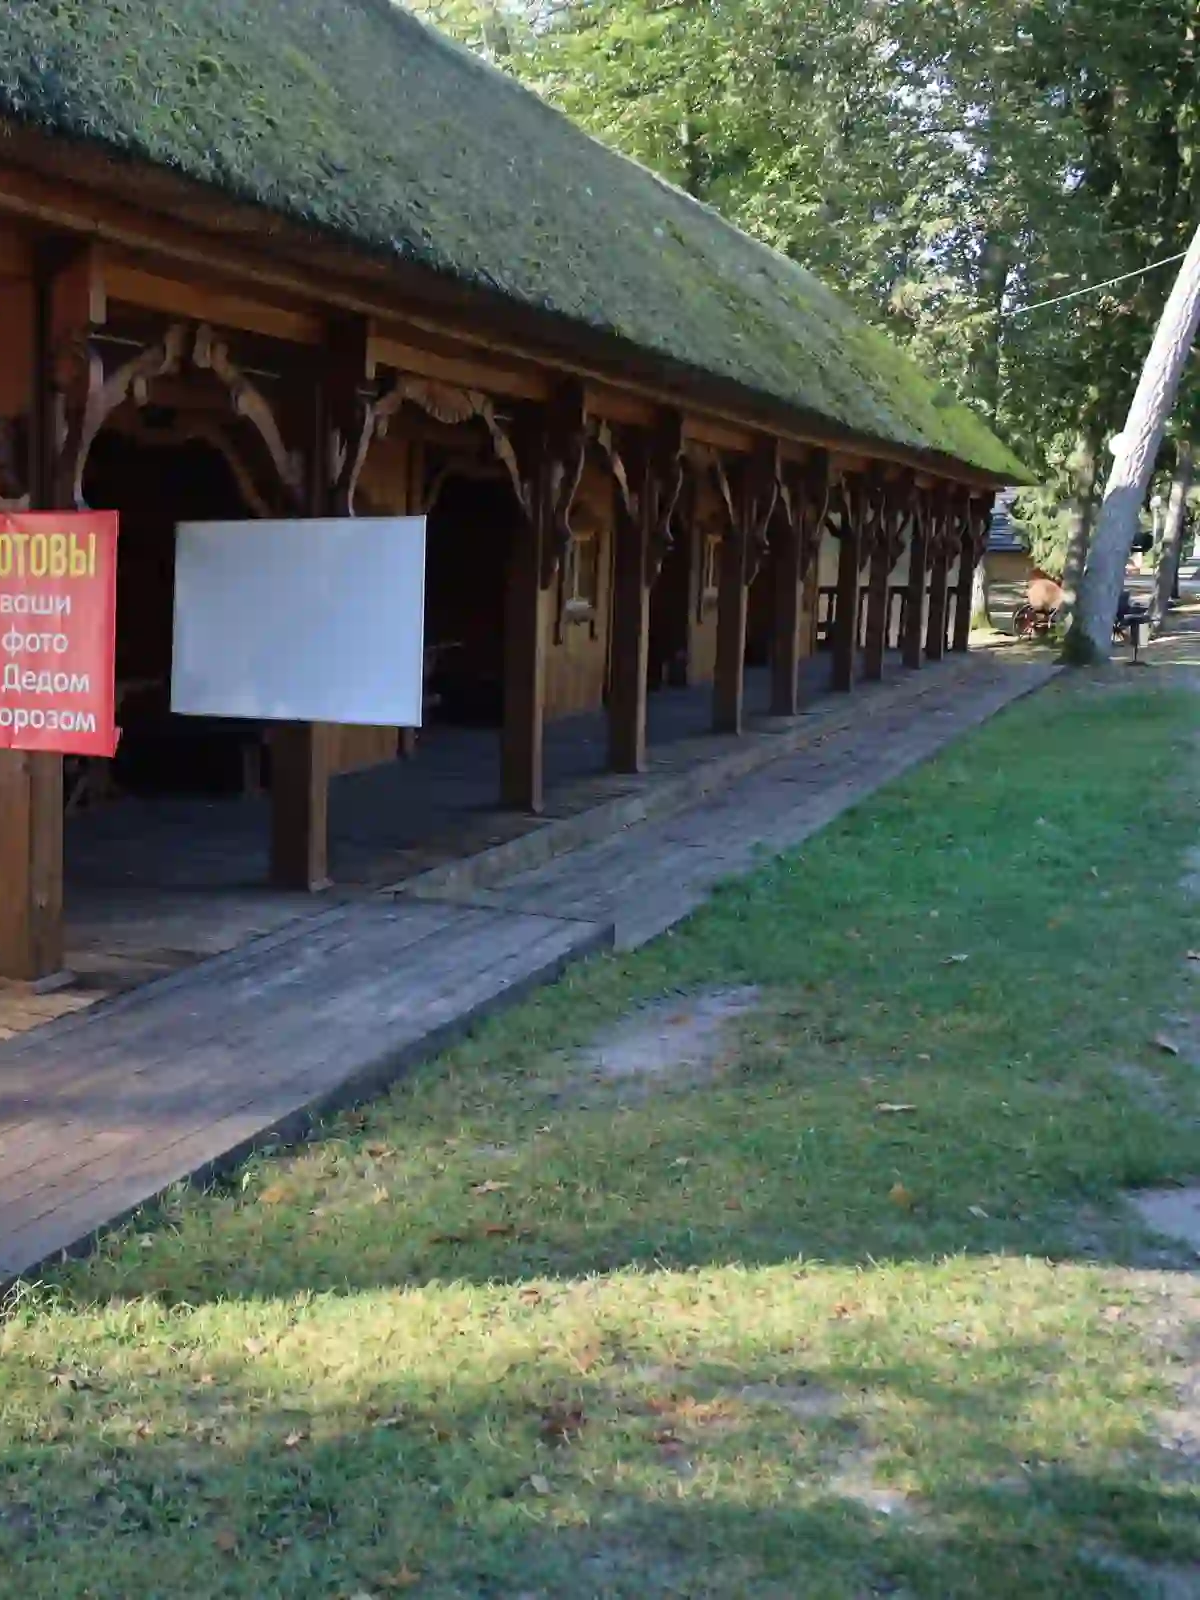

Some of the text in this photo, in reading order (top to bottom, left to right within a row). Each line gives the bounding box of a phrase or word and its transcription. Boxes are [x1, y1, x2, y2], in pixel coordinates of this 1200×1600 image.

[0, 593, 72, 616] ваши
[1, 622, 69, 658] фото
[1, 663, 90, 694] Дедом
